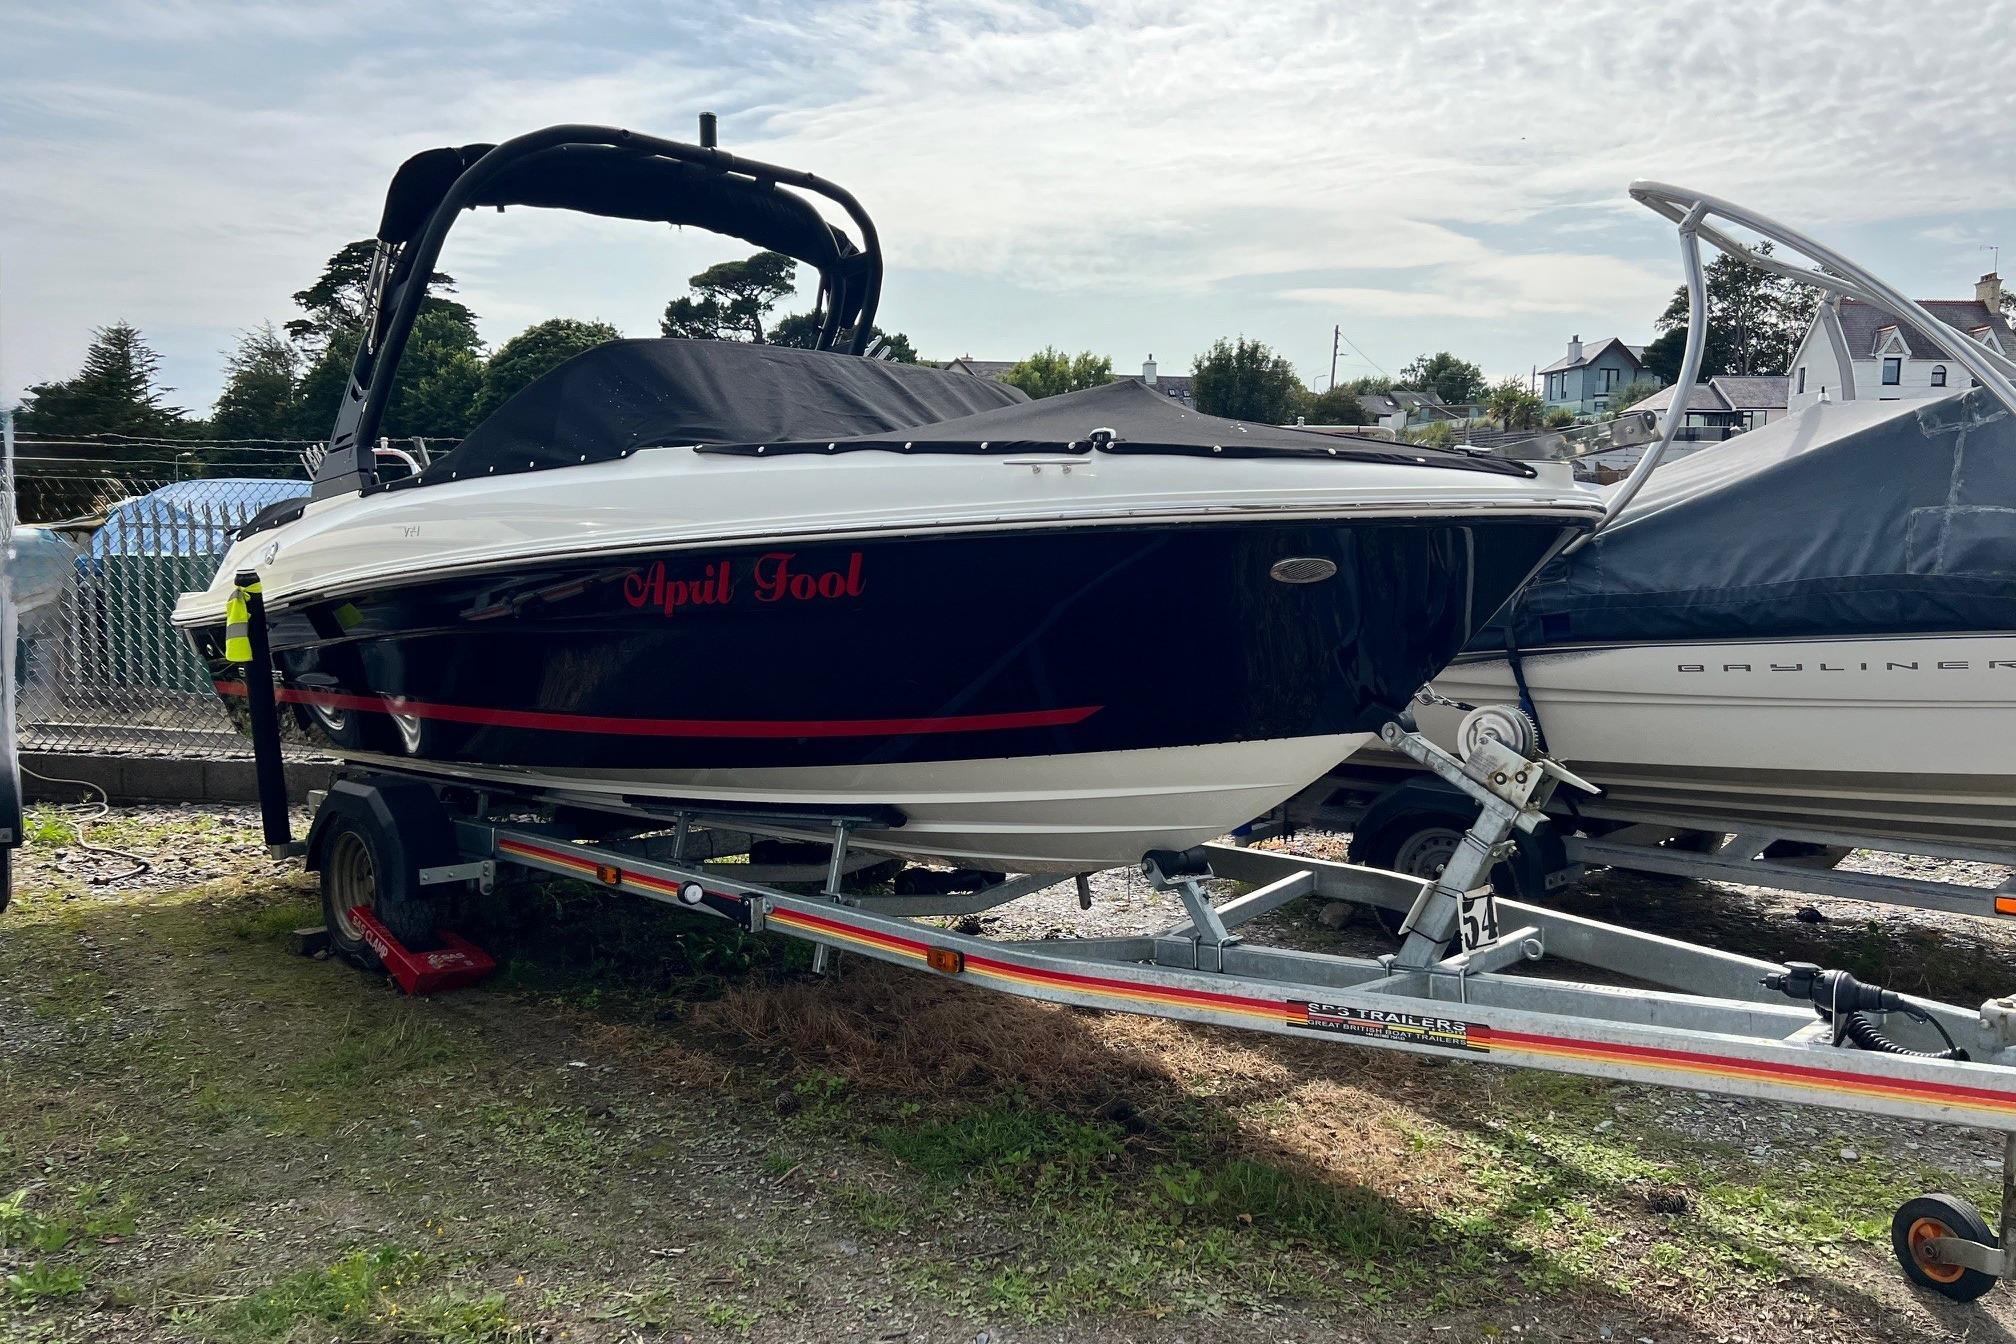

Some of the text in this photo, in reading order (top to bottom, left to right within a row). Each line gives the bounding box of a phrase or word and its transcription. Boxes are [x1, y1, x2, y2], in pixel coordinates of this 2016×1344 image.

[624, 552, 866, 618] April Fool
[1462, 895, 1498, 950] 54
[365, 929, 389, 959] CLAMP
[1307, 1020, 1340, 1029] GREAT
[1343, 1023, 1382, 1034] BRITISH
[1385, 1029, 1411, 1038] BOAT
[1416, 1033, 1467, 1046] TRAILERS
[1356, 1008, 1467, 1032] TRAILERS
